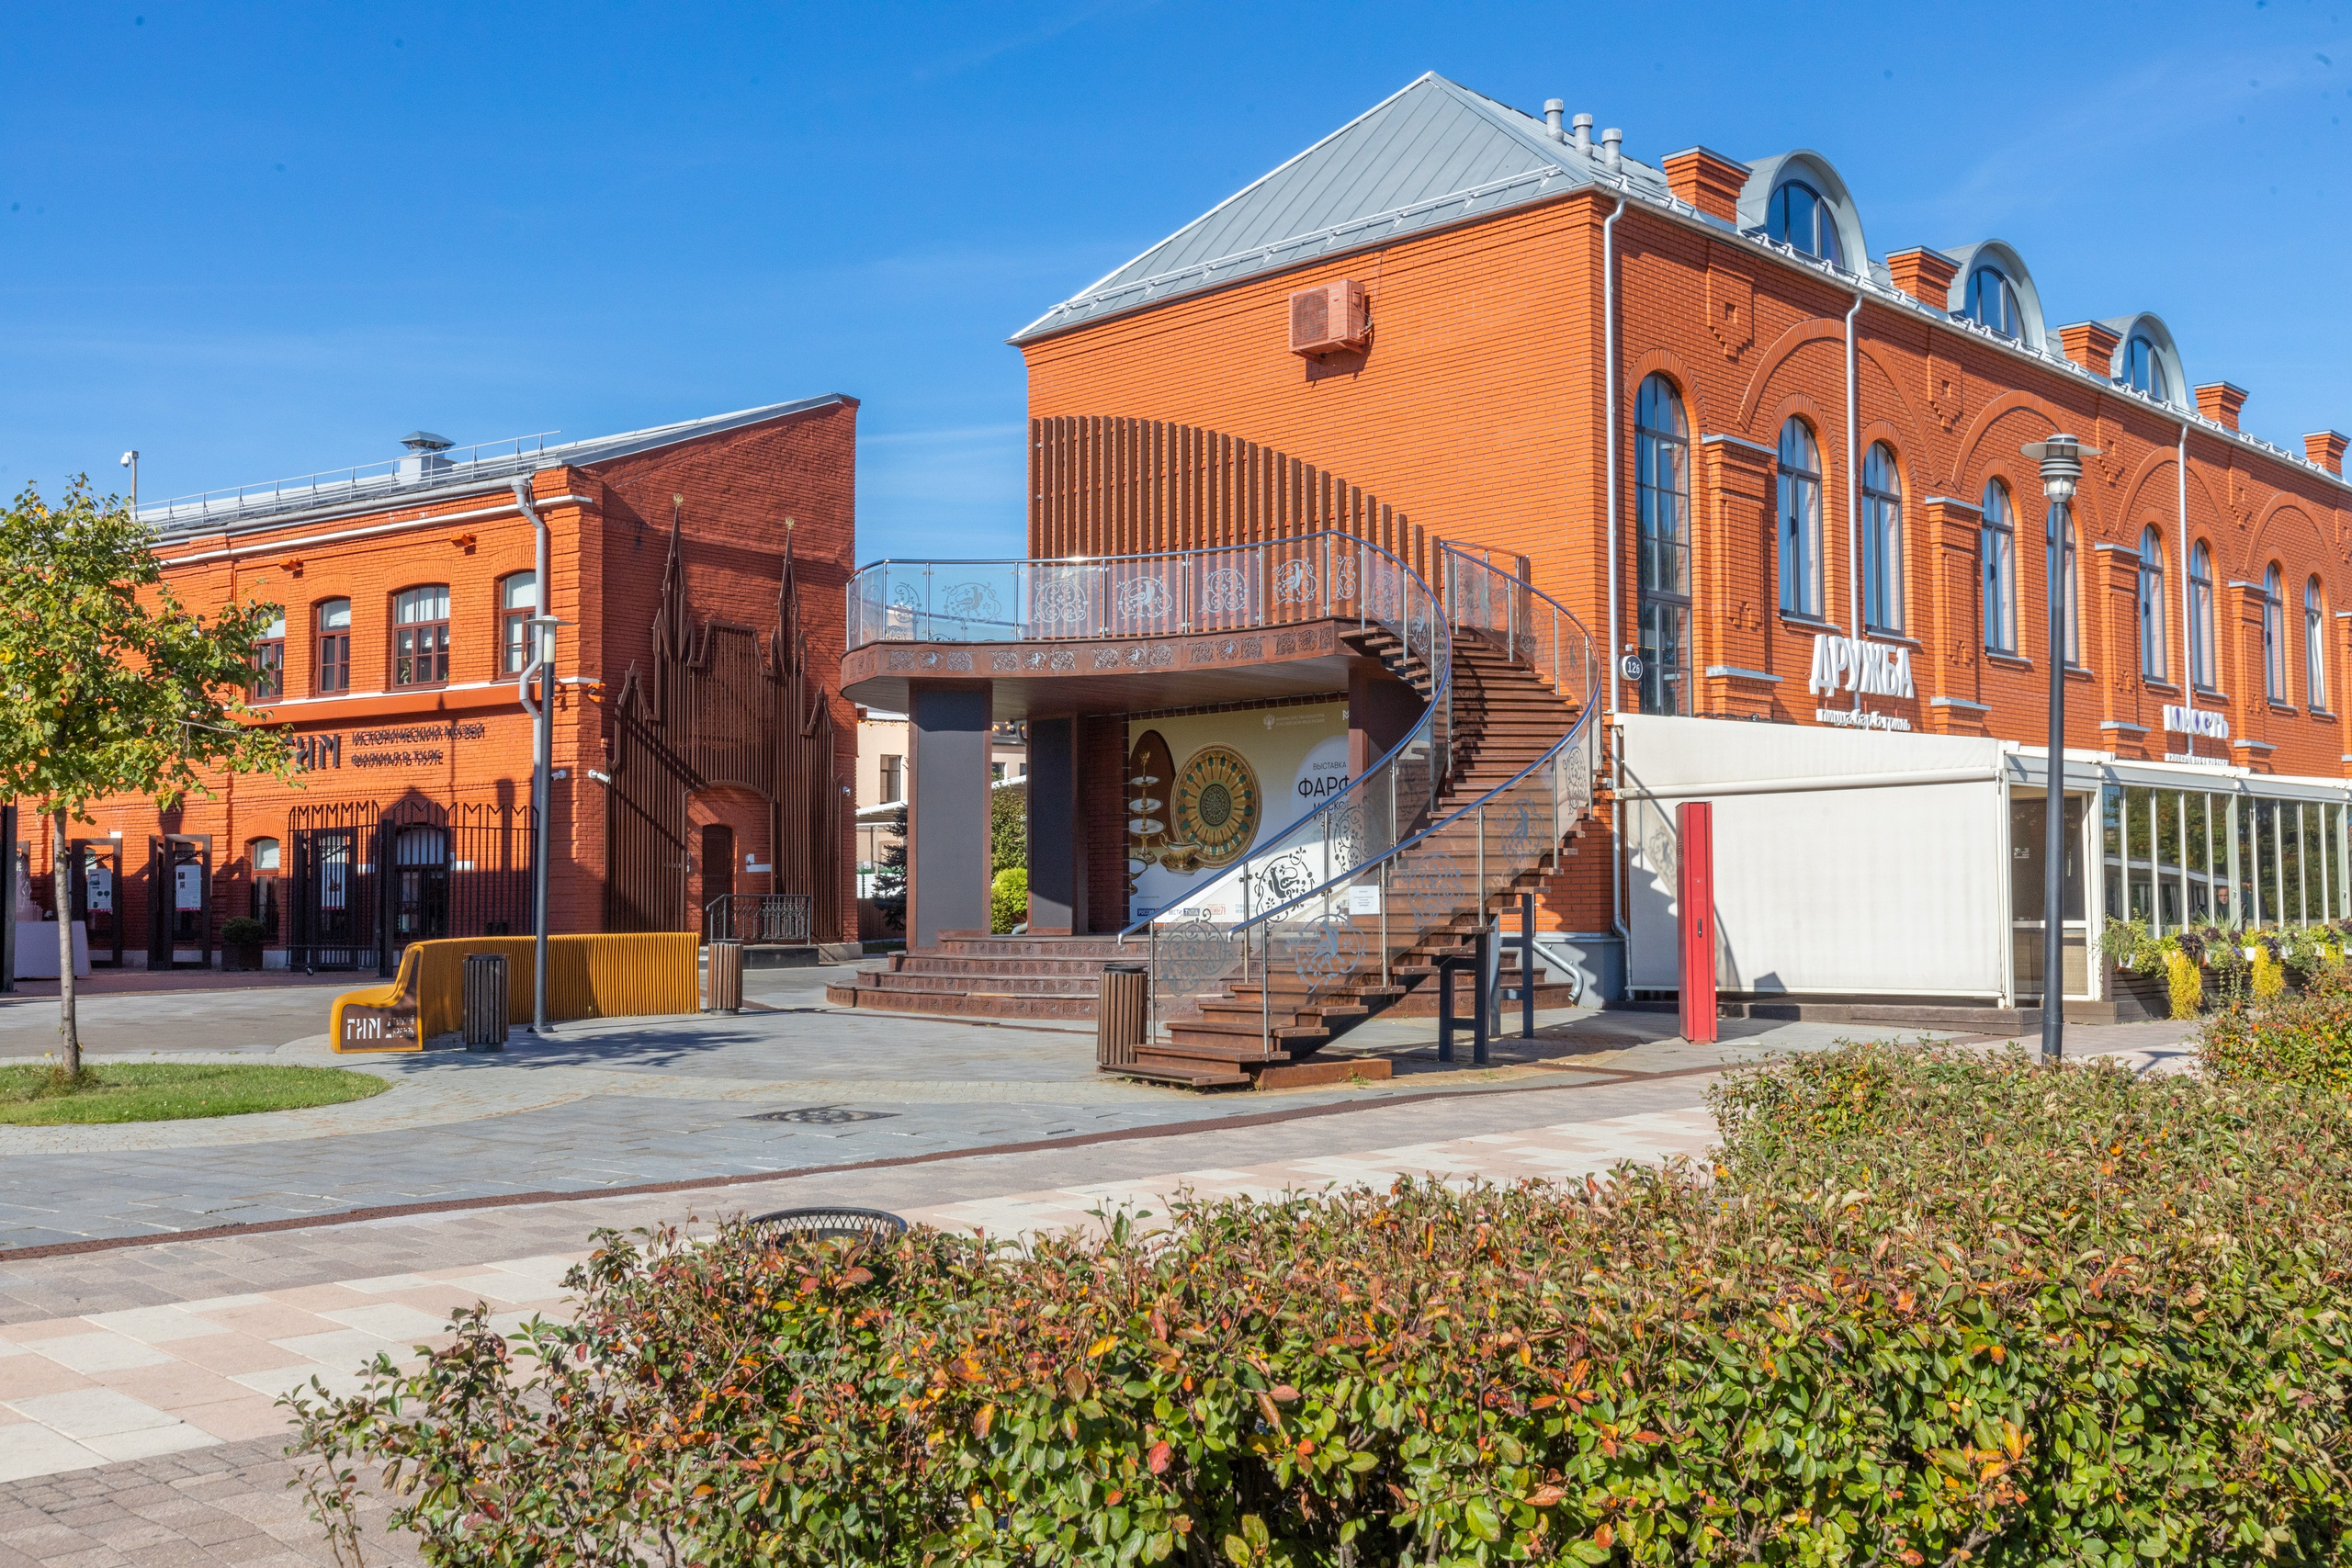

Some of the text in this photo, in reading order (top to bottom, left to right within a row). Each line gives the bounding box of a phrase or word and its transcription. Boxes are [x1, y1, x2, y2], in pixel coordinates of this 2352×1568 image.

[1809, 634, 1914, 698] ДРУЖБА
[352, 721, 484, 745] ИСТОРИЧЕСКИЙ МУЗЕЙ
[2163, 705, 2229, 739] ЮНОСТЬ
[351, 750, 401, 765] ФИЛИАЛ
[413, 749, 441, 763] ТУЛЕ
[1313, 761, 1347, 770] ВЫСТАВКА
